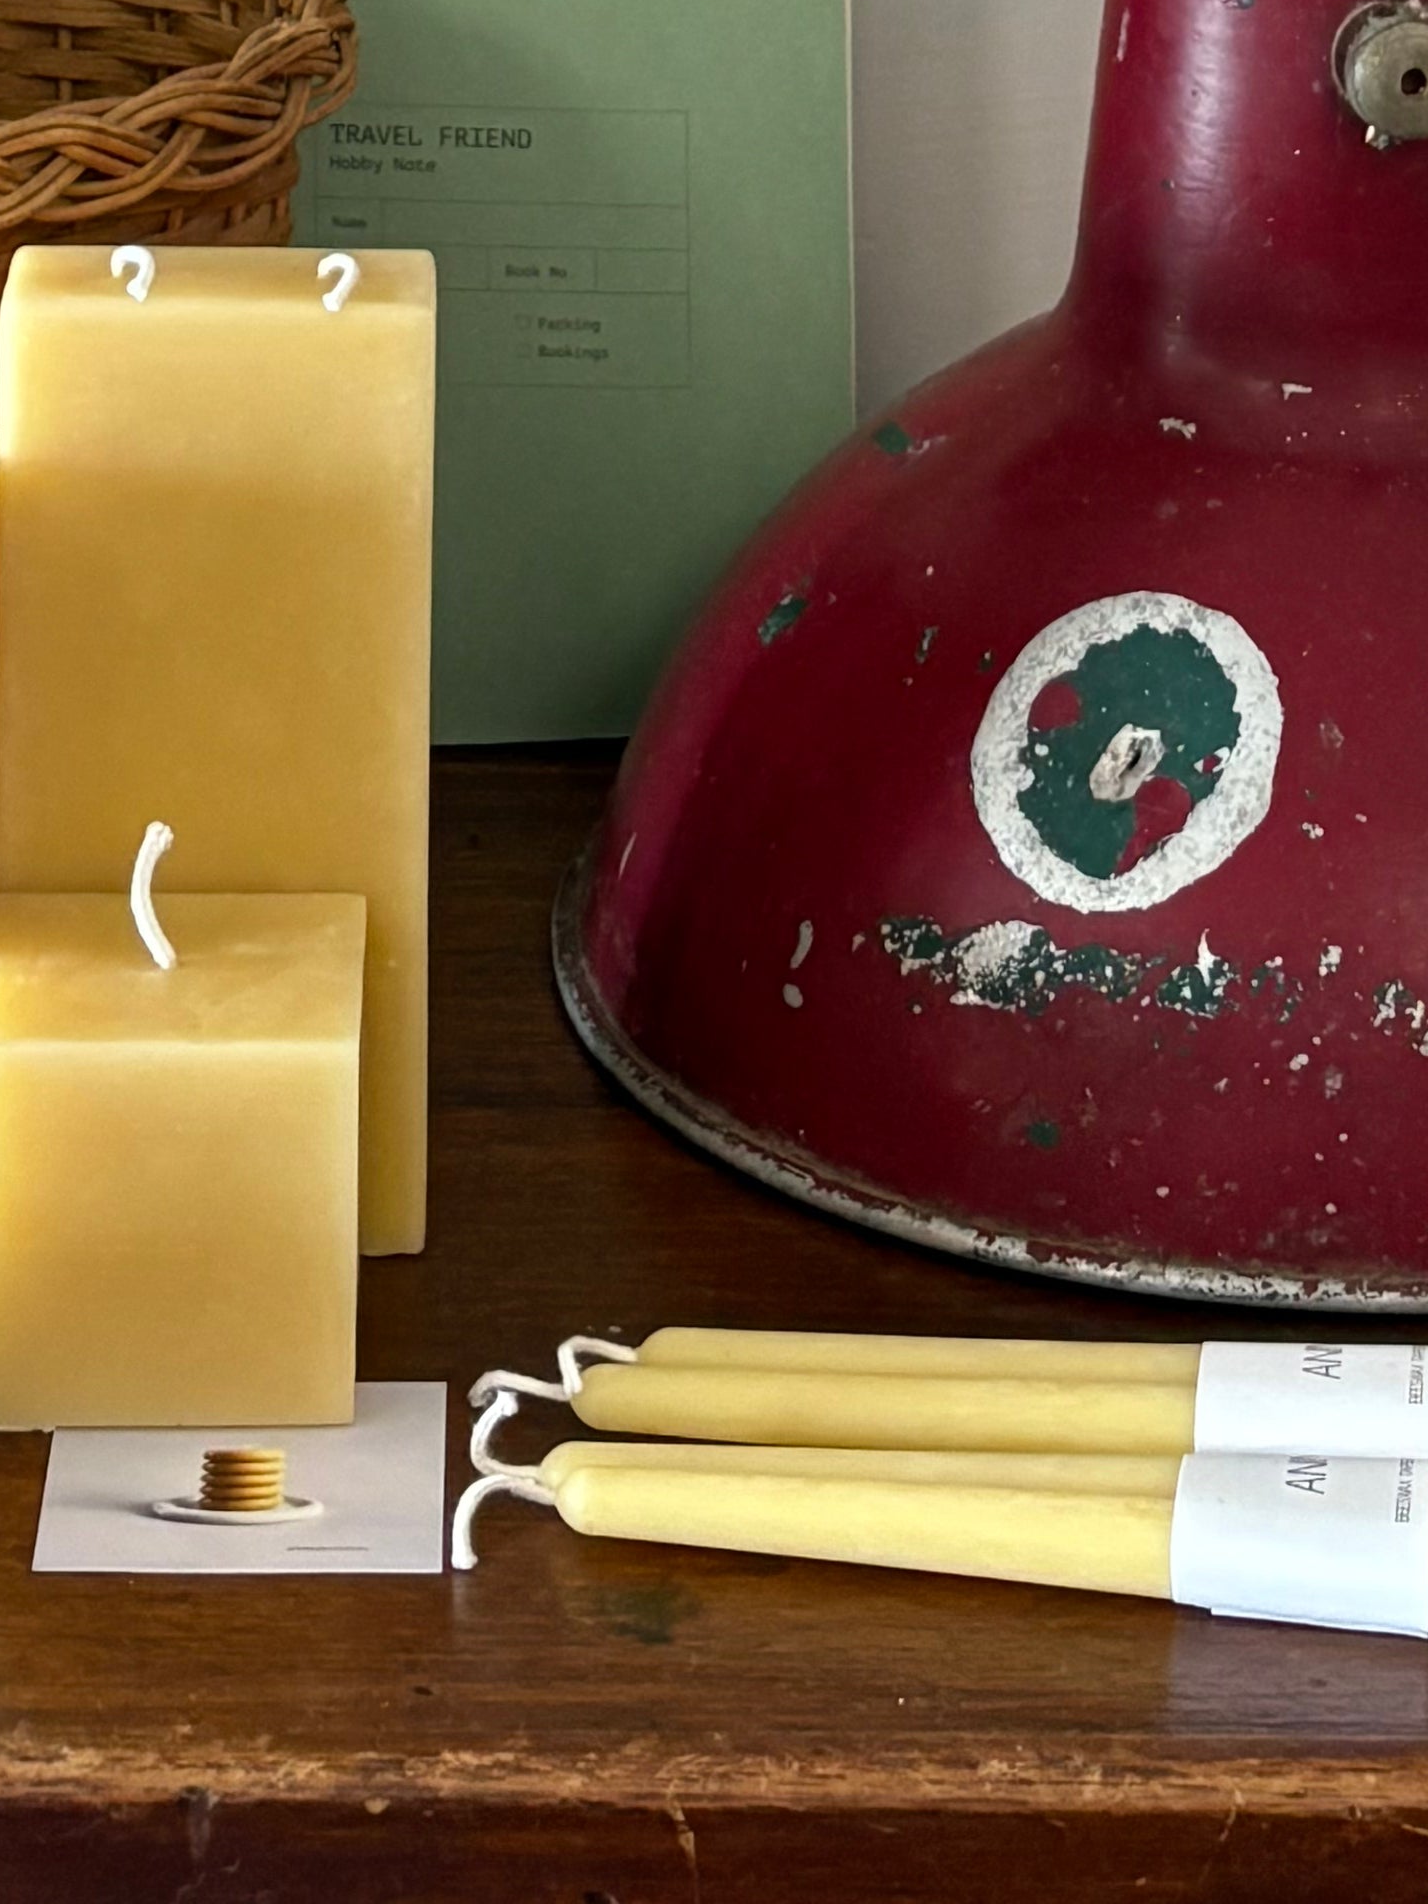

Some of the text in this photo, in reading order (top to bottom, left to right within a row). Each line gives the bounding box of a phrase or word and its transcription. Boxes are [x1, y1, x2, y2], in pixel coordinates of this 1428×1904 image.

[329, 123, 533, 149] TRAVEL FRIEND
[329, 155, 437, 174] Hobby Note
